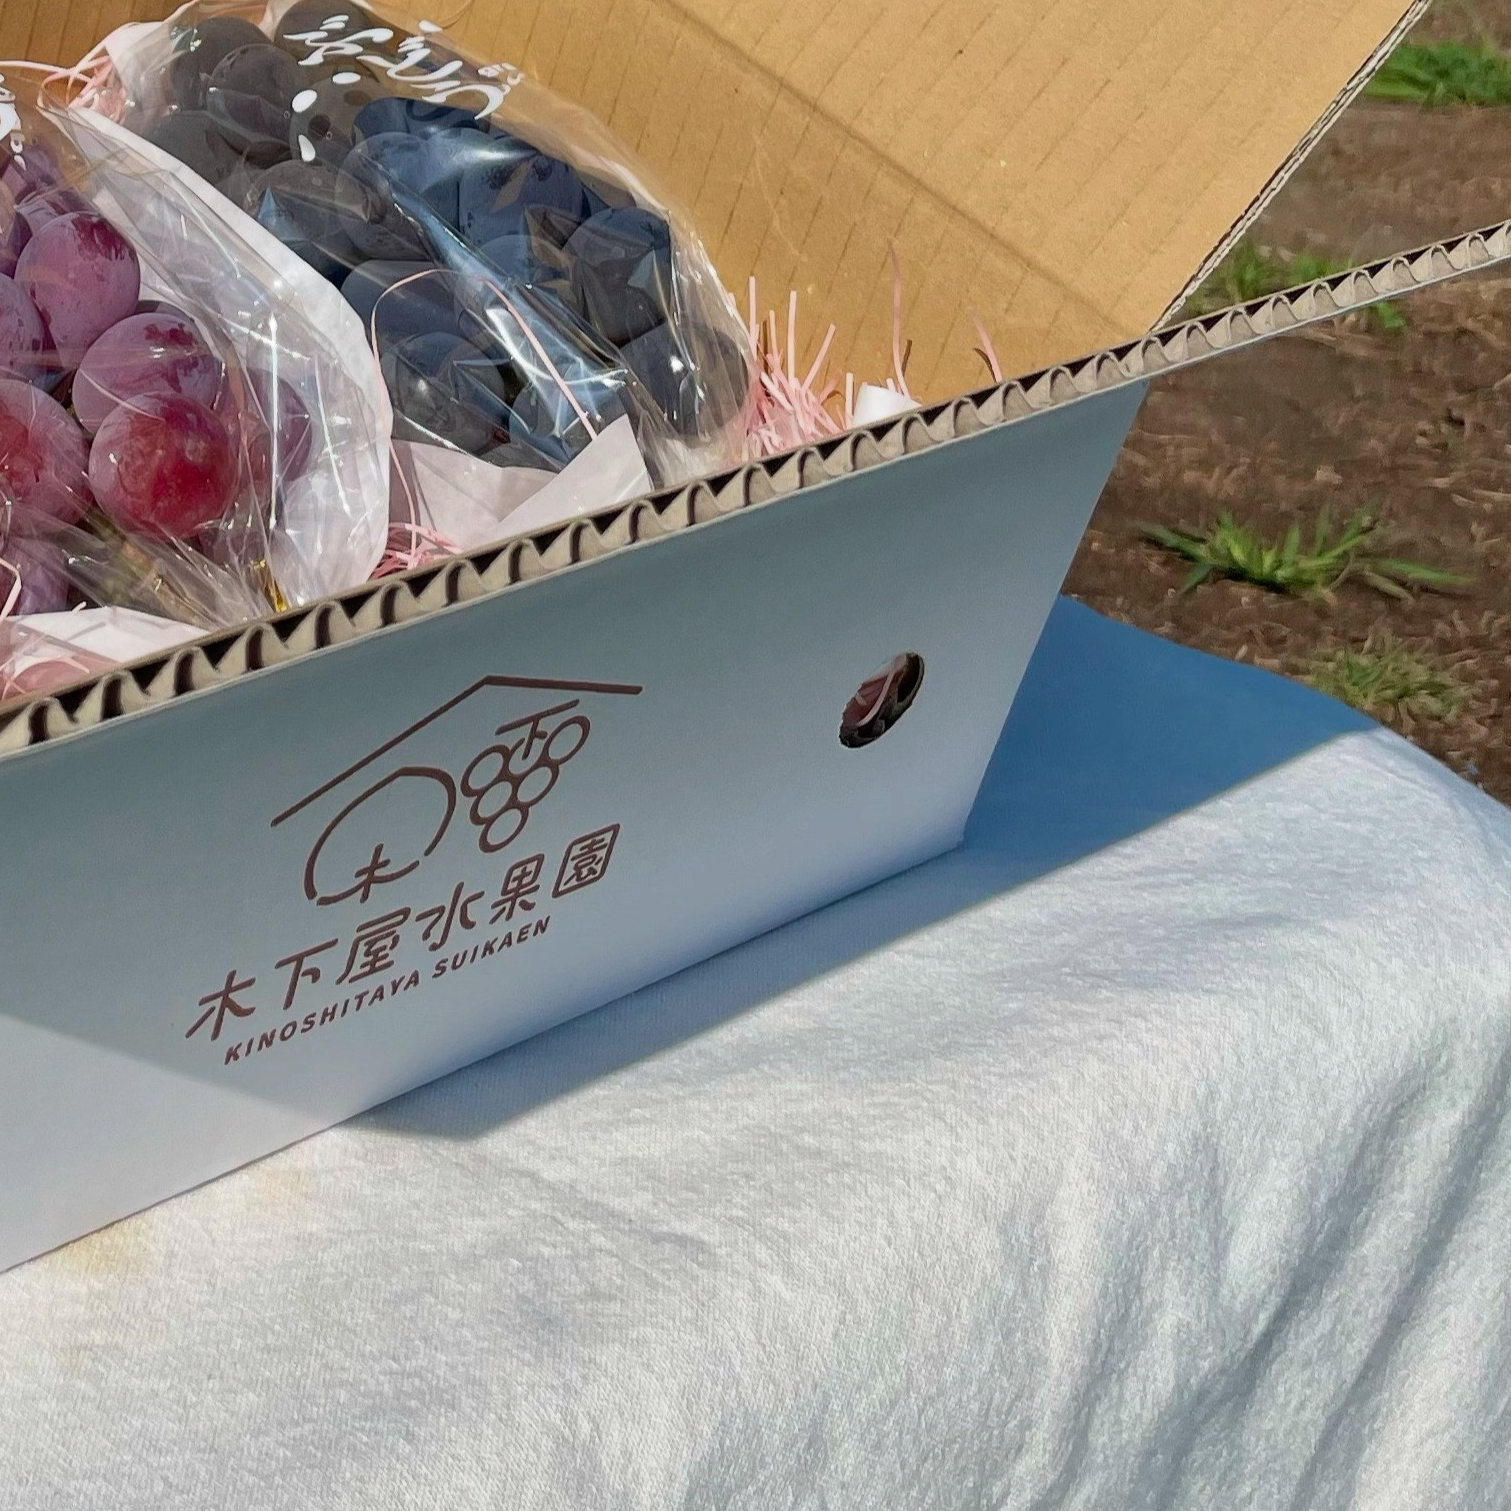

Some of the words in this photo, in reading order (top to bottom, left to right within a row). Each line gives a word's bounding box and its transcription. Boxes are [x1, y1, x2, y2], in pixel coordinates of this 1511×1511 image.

[186, 824, 620, 1041] 木下屋水果園
[224, 969, 420, 1066] KINOSHITAYA
[432, 916, 551, 978] SUIKAEN
